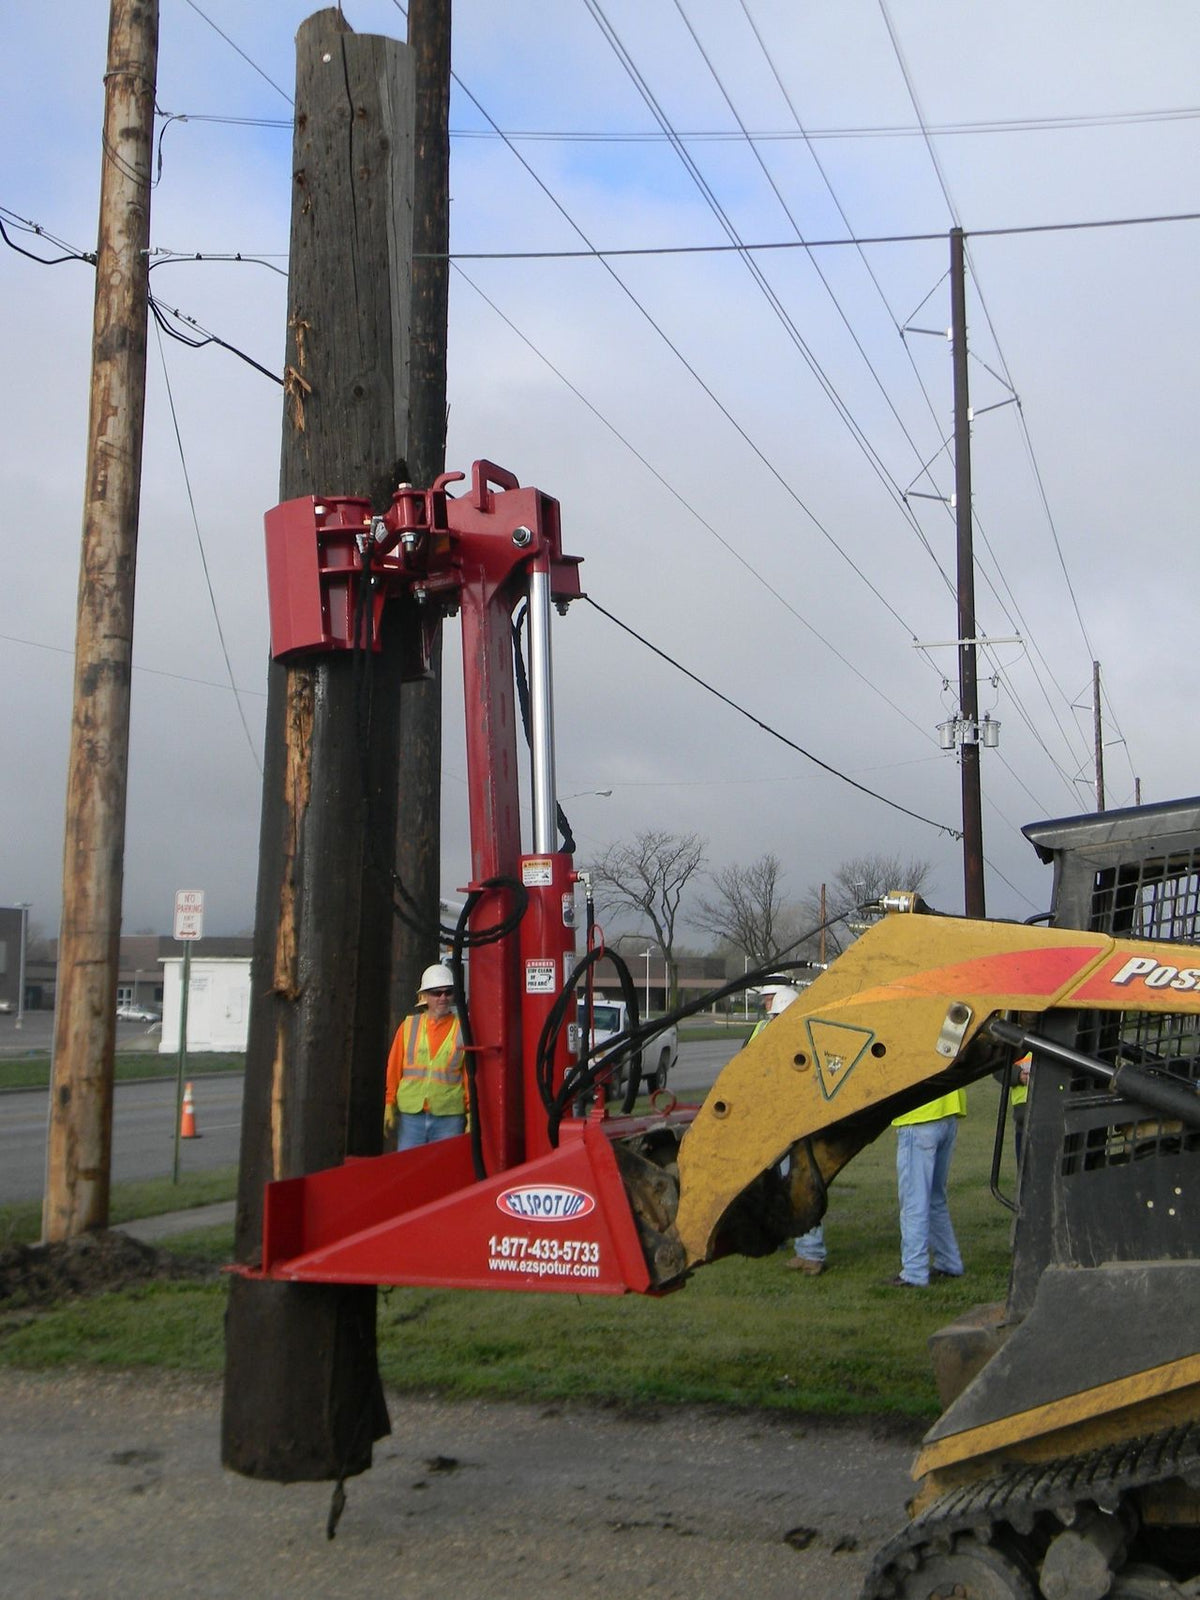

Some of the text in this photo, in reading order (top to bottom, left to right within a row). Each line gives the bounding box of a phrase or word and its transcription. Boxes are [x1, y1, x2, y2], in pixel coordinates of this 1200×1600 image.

[184, 894, 195, 903] NO
[176, 904, 203, 913] PARKING
[505, 1193, 586, 1215] EZ SPOT UR
[488, 1236, 599, 1263] 1-877-433-5733
[488, 1258, 600, 1277] www.ezspotur.com
